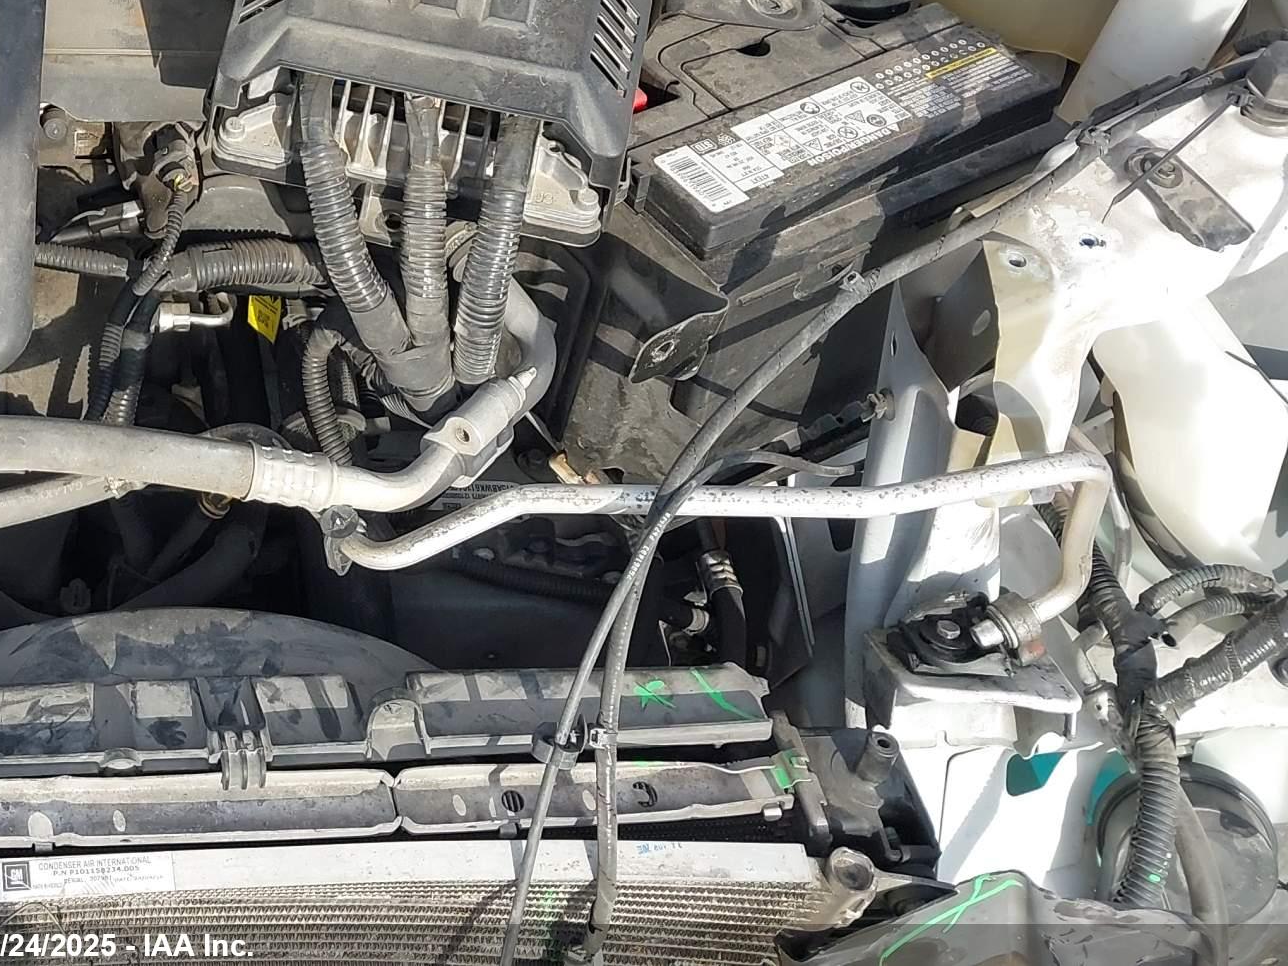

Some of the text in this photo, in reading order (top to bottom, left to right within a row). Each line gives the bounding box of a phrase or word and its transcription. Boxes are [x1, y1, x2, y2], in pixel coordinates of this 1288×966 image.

[38, 856, 152, 871] CONDENSER AIR INTERNATIONAL
